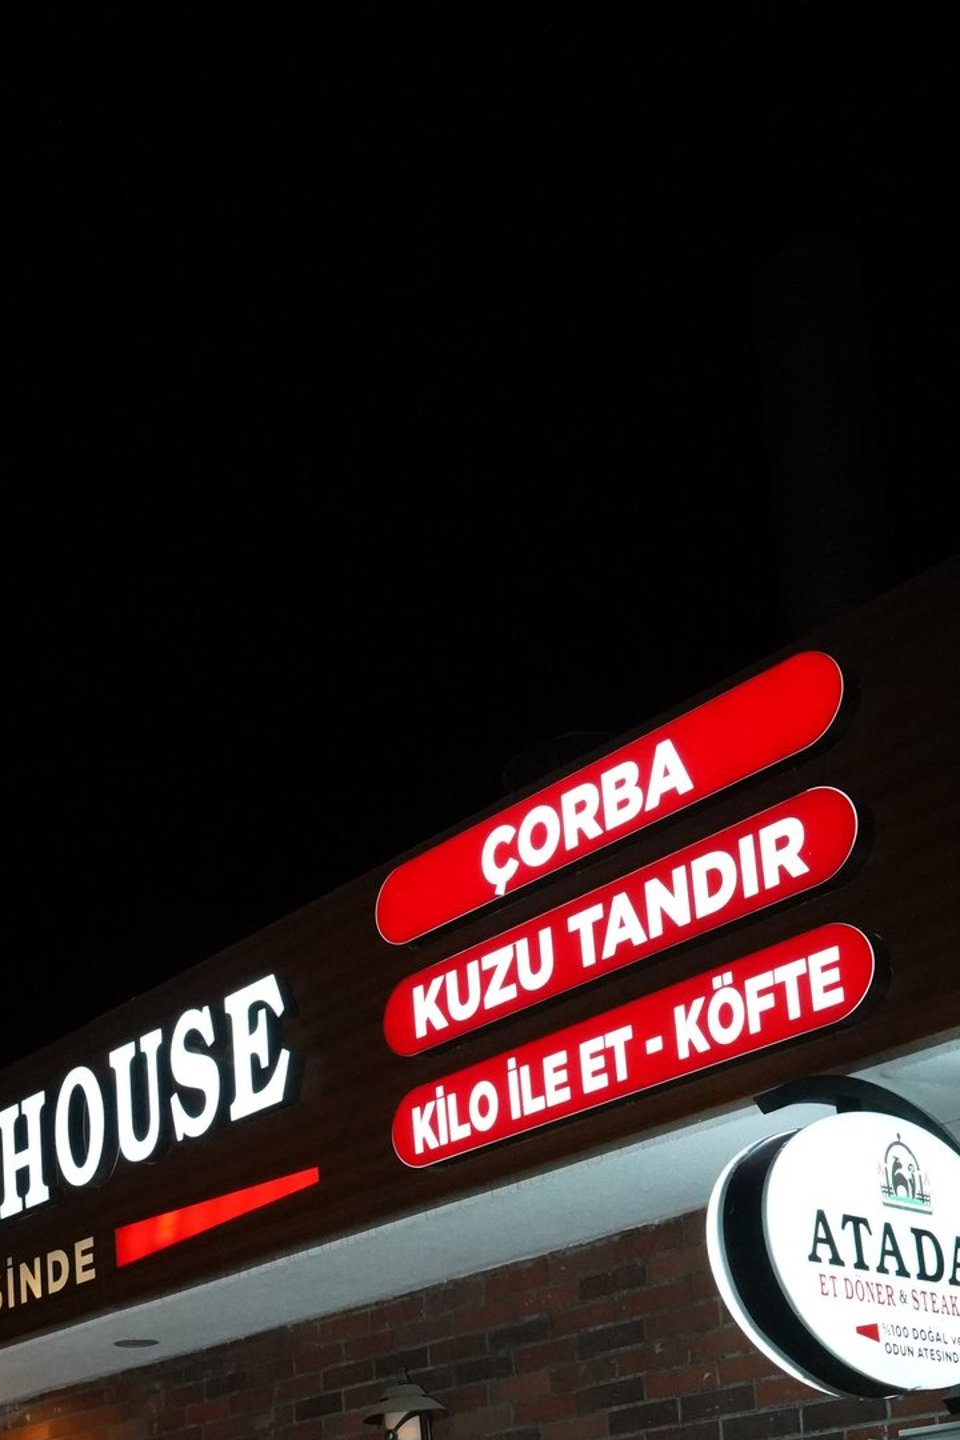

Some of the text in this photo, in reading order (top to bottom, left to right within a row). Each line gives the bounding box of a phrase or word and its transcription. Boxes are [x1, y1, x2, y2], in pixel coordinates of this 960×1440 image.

[480, 738, 694, 895] ÇORBA
[411, 816, 810, 1039] KUZU TANDIR
[412, 1085, 499, 1154] KİLO
[507, 1057, 571, 1120] İLE
[579, 1025, 634, 1094] ET
[674, 945, 845, 1060] KÖFTE
[819, 1273, 839, 1297] ET
[844, 1273, 896, 1307] DÖNER
[899, 1289, 908, 1304] &
[885, 1342, 914, 1357] ODUN
